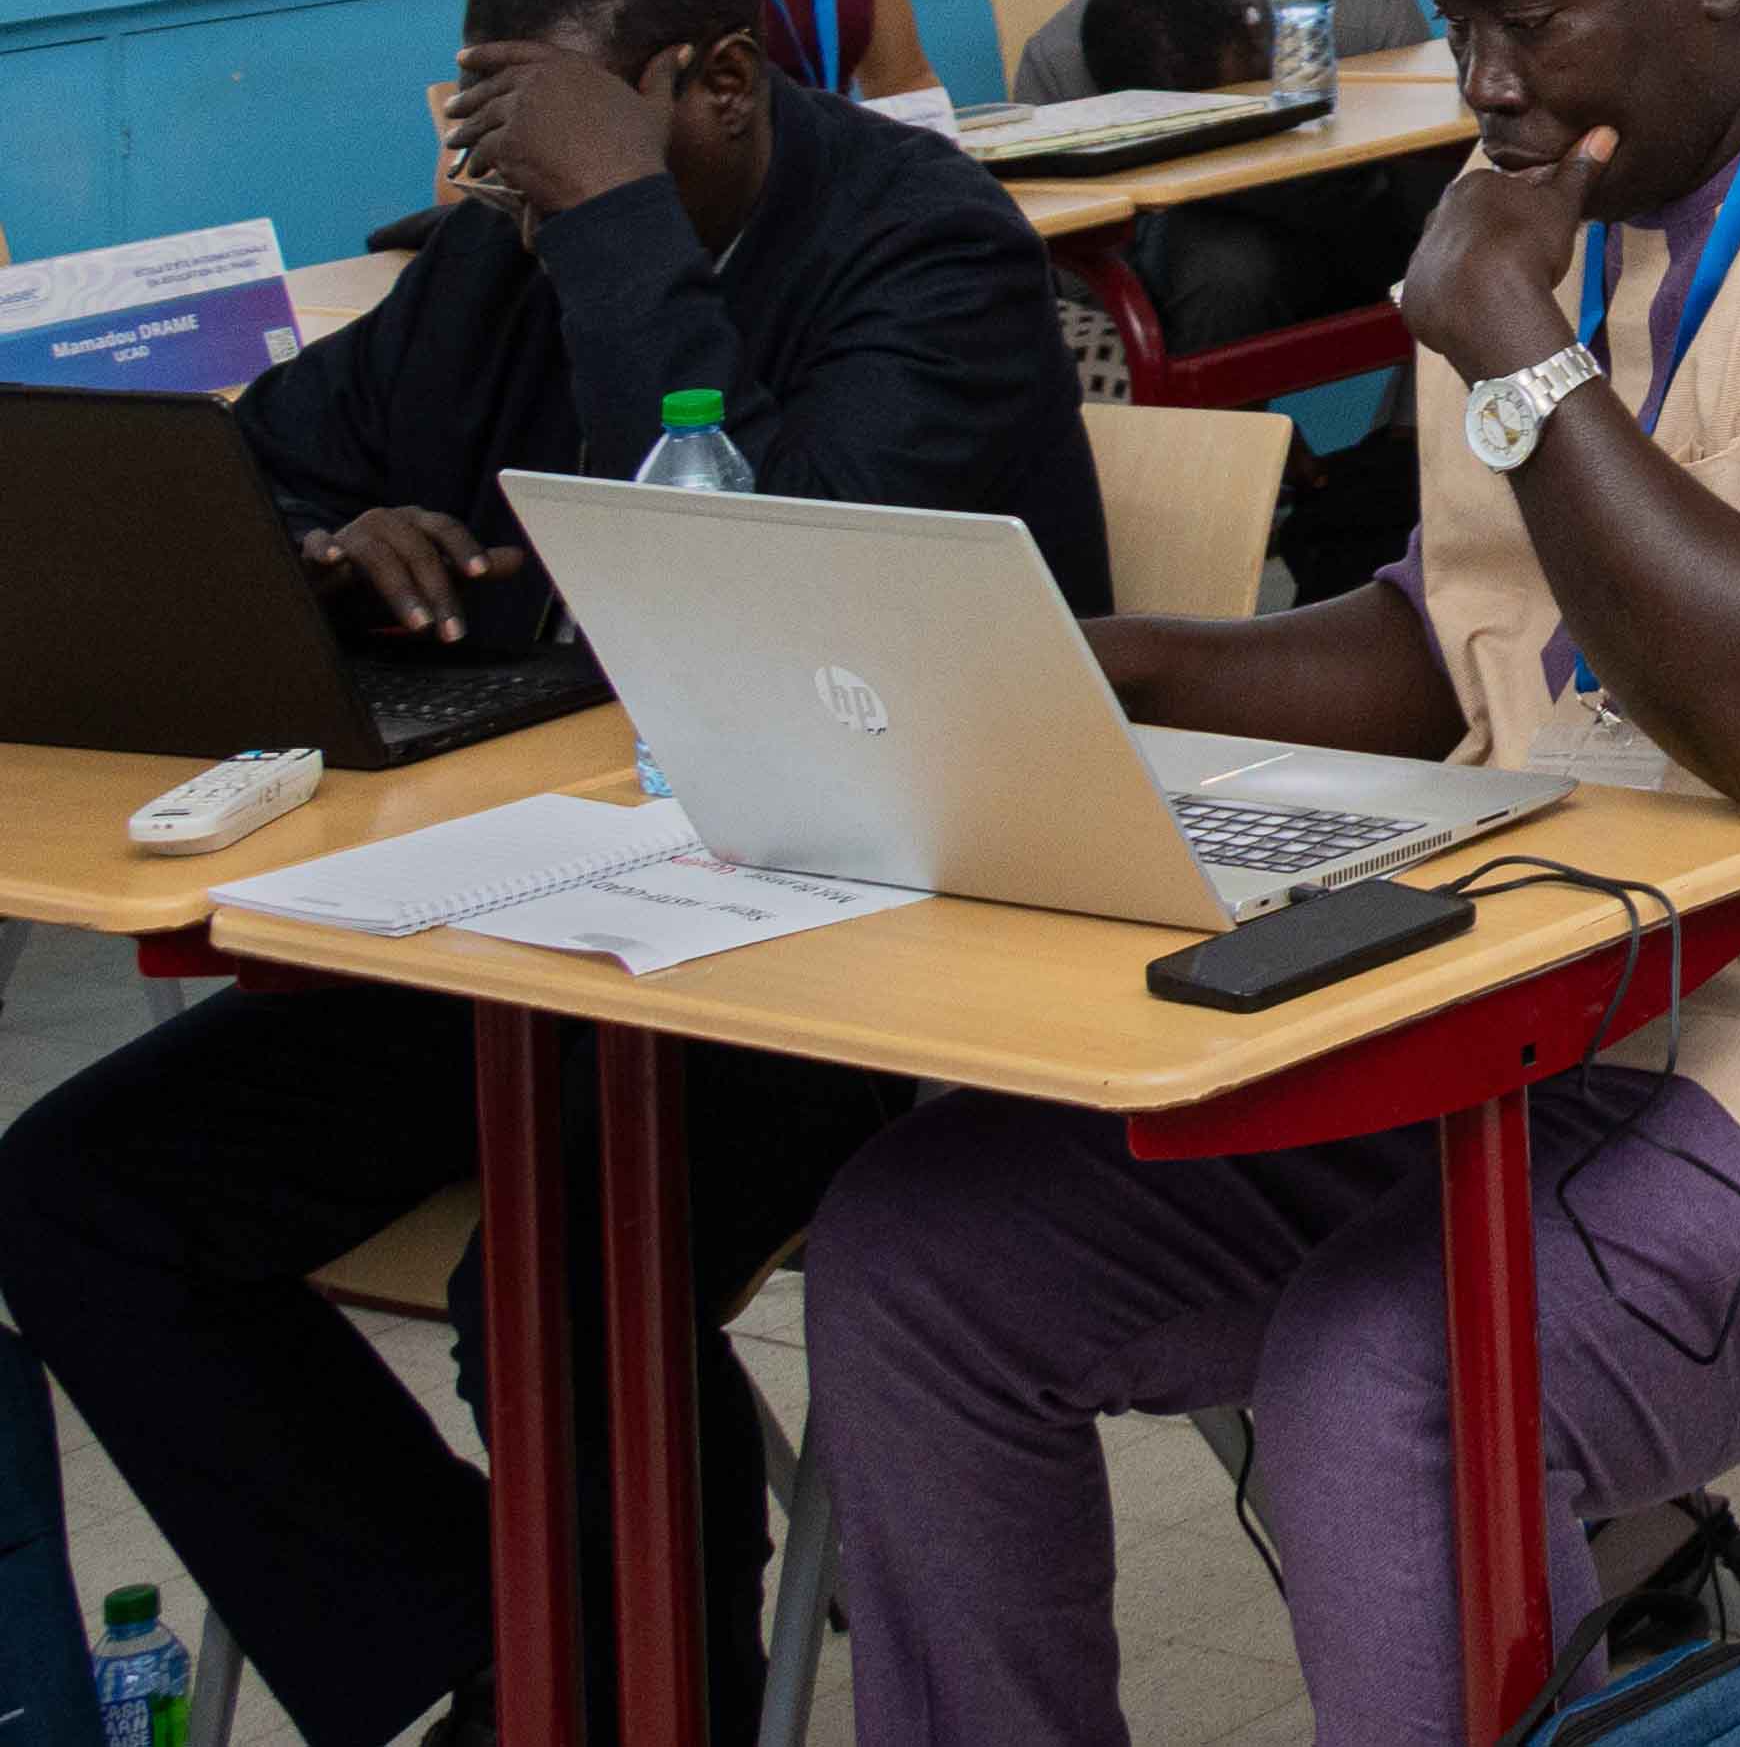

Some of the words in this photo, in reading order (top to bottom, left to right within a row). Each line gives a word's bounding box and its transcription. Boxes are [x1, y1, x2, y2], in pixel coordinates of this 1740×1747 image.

[53, 332, 137, 358] Mamadou
[140, 314, 199, 339] DRAME
[113, 346, 150, 362] UCAD
[816, 666, 886, 734] hp
[102, 1700, 149, 1719] ASA
